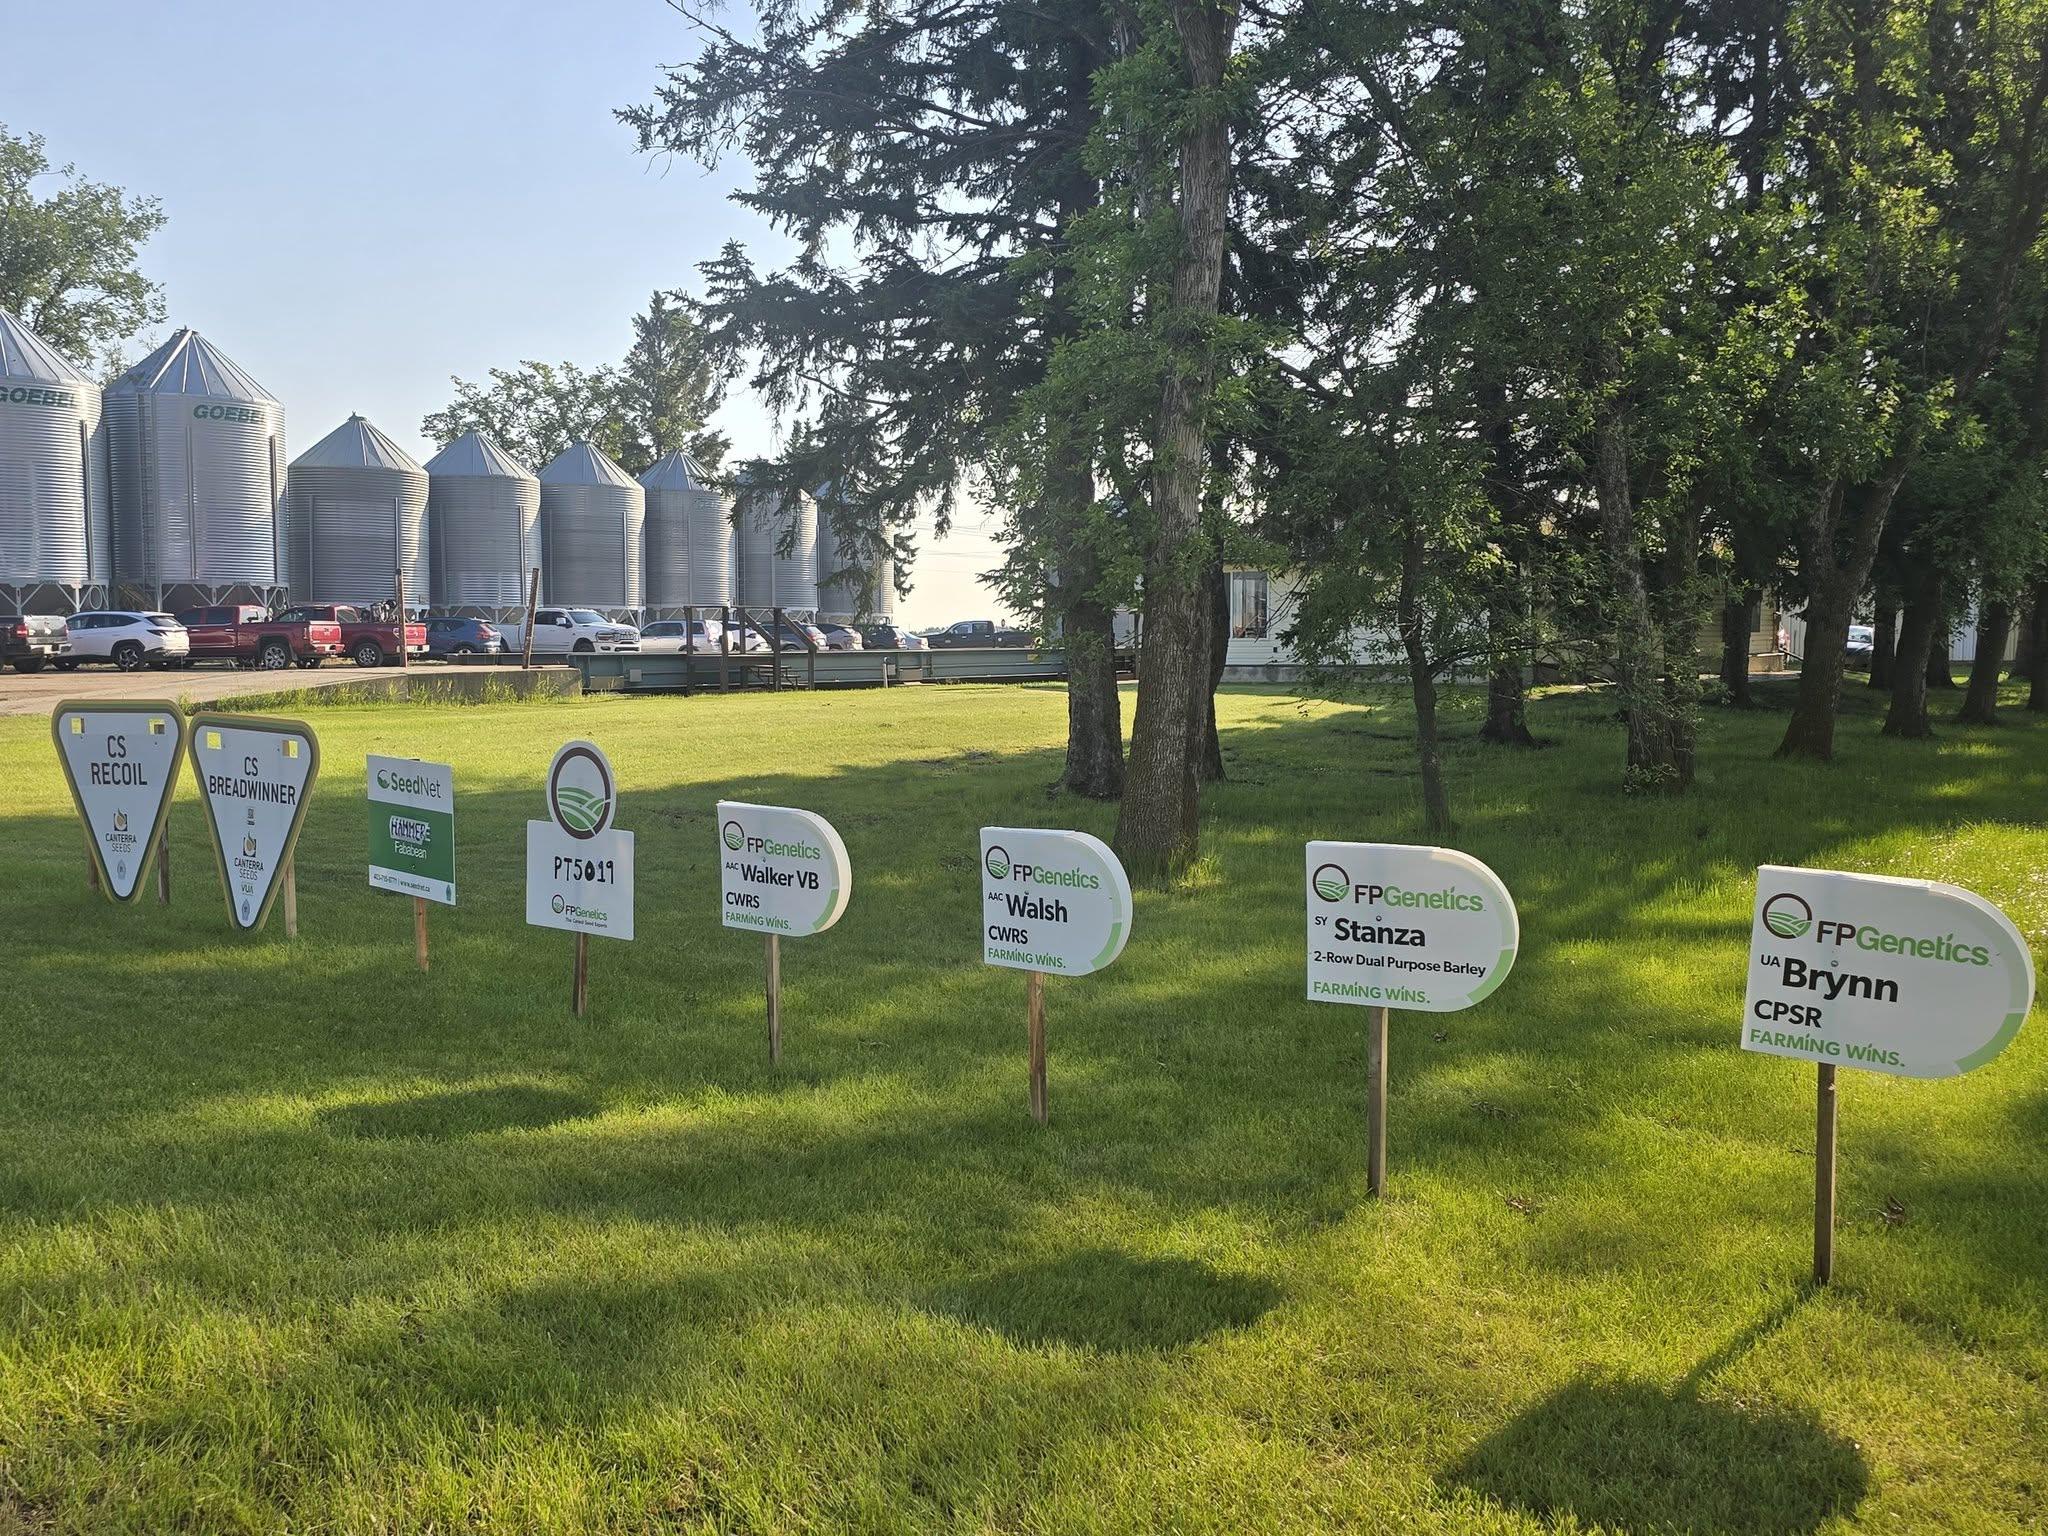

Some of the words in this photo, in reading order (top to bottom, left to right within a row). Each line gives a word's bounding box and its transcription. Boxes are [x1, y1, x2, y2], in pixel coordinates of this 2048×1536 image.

[0, 386, 74, 408] GOEBE
[193, 404, 265, 423] GOEBE
[107, 735, 127, 758] CS
[91, 762, 148, 785] RECOIL
[244, 756, 259, 776] CS
[209, 775, 296, 806] BREADWINNER
[391, 772, 441, 798] SeedNet
[105, 833, 137, 843] CANTERRA
[111, 843, 131, 853] SEEDS
[395, 840, 427, 859] Fababean
[747, 837, 820, 860] FPGenetics
[234, 857, 264, 871] CANTERRA
[240, 868, 258, 881] SEEDS
[554, 856, 614, 885] PT5019
[725, 862, 739, 871] AAC
[741, 863, 794, 887] Walker
[797, 870, 820, 890] VB
[1013, 864, 1099, 889] FPGenetics
[726, 891, 760, 909] CWRS
[988, 892, 1003, 901] AAC
[1006, 893, 1068, 923] Walsh
[1354, 884, 1483, 912] FPGenetics
[565, 905, 608, 921] FPGenetics
[988, 925, 1028, 944] CWRS
[1315, 916, 1328, 926] SY
[1334, 917, 1425, 947] Stanza
[1816, 921, 1989, 966] FPGenetics
[1314, 951, 1353, 964] 2-Row
[1356, 954, 1384, 968] Dual
[1387, 957, 1441, 972] Purpose
[1443, 961, 1486, 977] Barley
[1760, 954, 1781, 968] UA
[1782, 957, 1899, 1003] Brynn
[1754, 1000, 1822, 1028] CPSR
